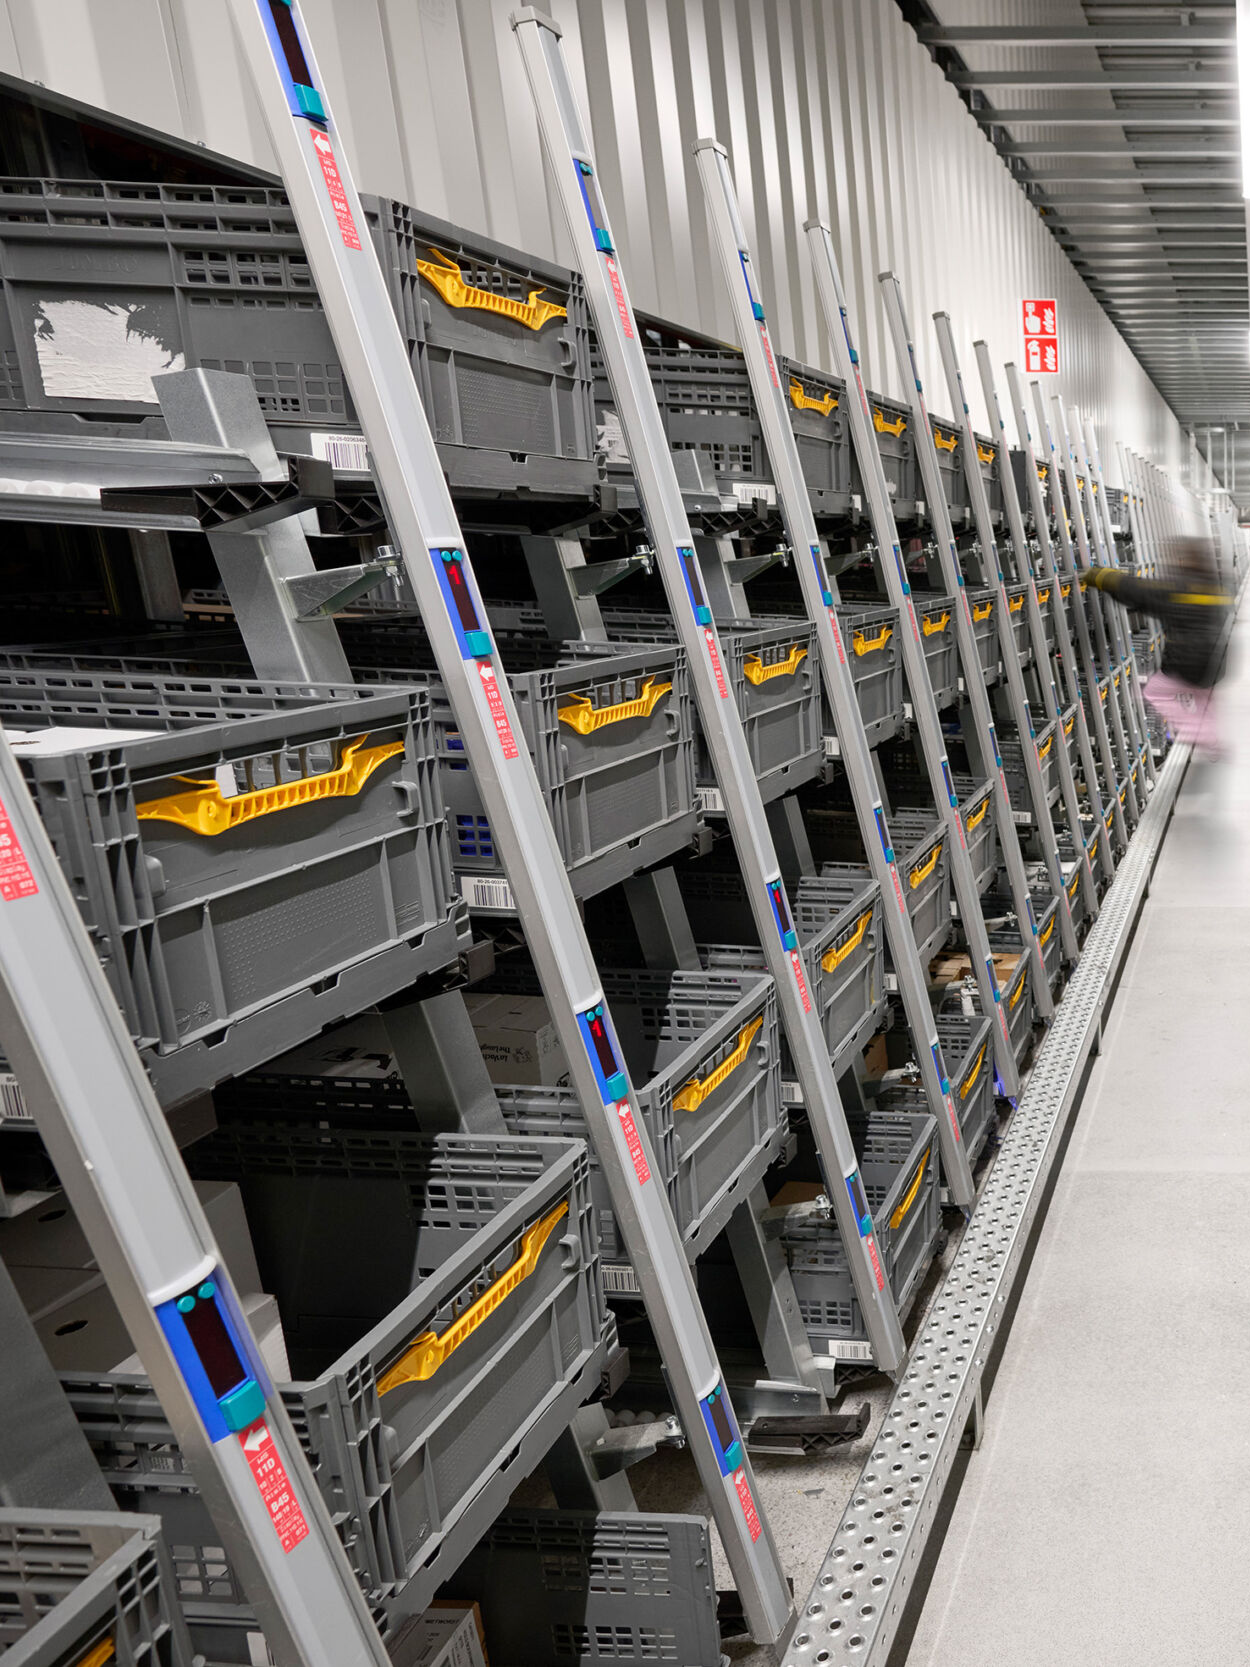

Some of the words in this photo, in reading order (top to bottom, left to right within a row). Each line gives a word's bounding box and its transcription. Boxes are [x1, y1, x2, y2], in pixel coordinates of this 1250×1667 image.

[449, 565, 461, 585] 1
[592, 1019, 602, 1037] 1
[270, 1492, 290, 1512] B45
